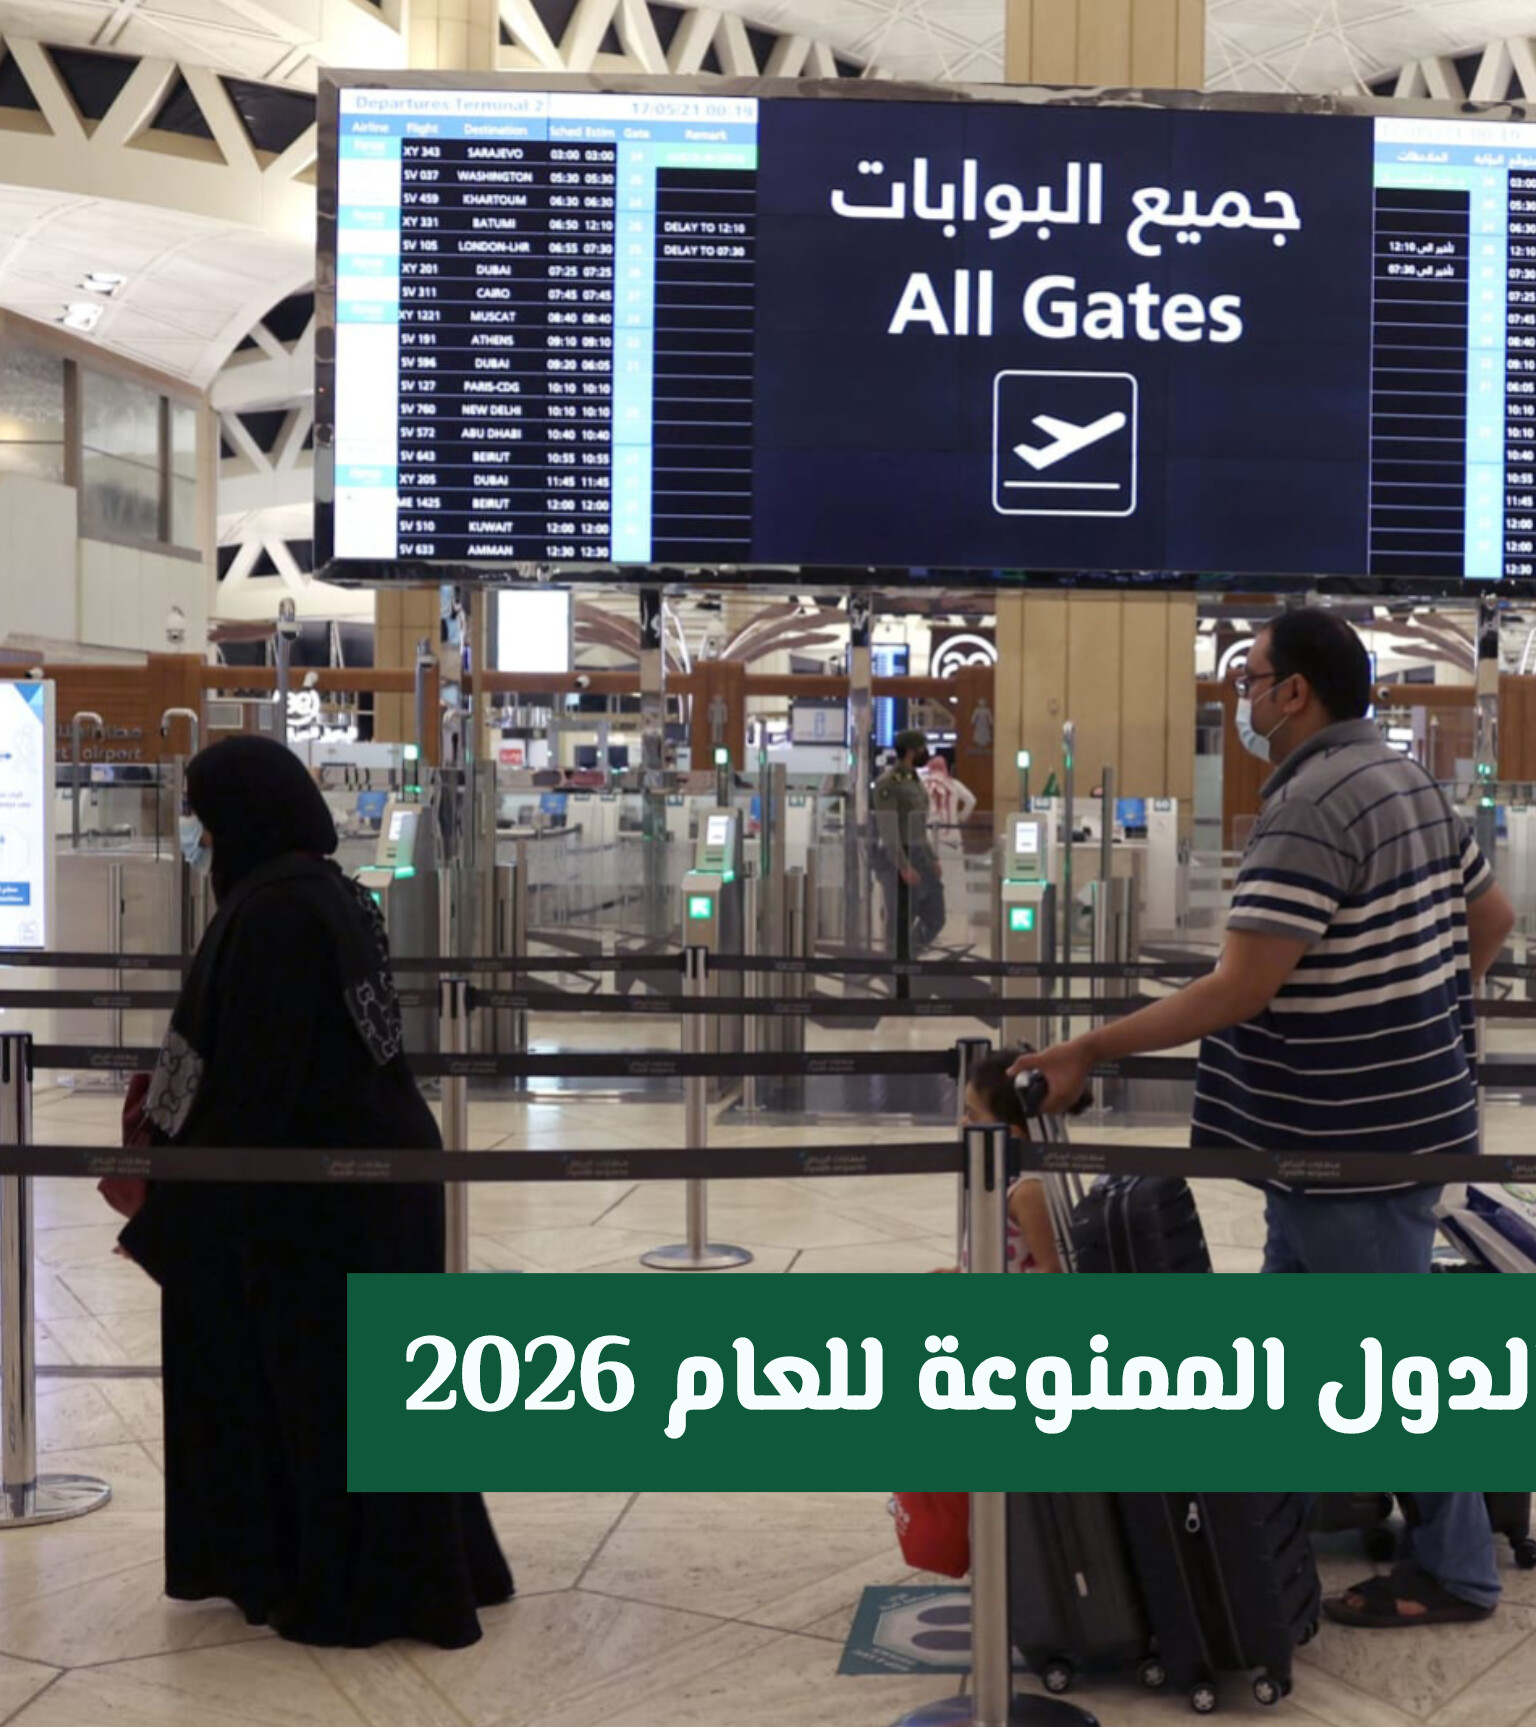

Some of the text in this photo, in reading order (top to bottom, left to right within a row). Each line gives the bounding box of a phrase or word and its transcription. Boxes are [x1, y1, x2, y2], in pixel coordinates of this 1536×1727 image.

[356, 96, 545, 113] Departures Terminal 2
[351, 121, 390, 134] Airline
[406, 122, 439, 137] Flight
[463, 123, 529, 137] Destination
[549, 126, 583, 139] Sched
[623, 128, 651, 140] Gate
[684, 128, 728, 141] Remark
[403, 146, 419, 159] XY
[466, 147, 524, 160] SARAJEVO
[403, 170, 419, 182] SV
[456, 171, 534, 183] WASHINGTON
[403, 193, 418, 205] SV
[462, 194, 528, 206] KHARTOUM
[831, 157, 1301, 257] جميع البوابات
[402, 216, 418, 229] XY
[472, 217, 518, 230] BATUMI
[664, 221, 698, 234] DELAY
[699, 221, 716, 234] TO
[718, 222, 746, 235] 12:10
[403, 240, 418, 252] SV
[458, 241, 530, 253] LONDON-LHR
[663, 244, 697, 257] DELAY
[698, 244, 715, 257] TO
[717, 245, 746, 258] 07:30
[402, 263, 418, 276] XY
[476, 264, 512, 276] DUBAI
[402, 286, 417, 299] SV
[476, 287, 510, 300] CAIRO
[888, 268, 1243, 343] All Gates
[398, 310, 417, 322] XY
[470, 311, 516, 323] MUSCAT
[402, 333, 417, 346] SV
[470, 334, 514, 346] ATHENS
[402, 356, 416, 369] SV
[474, 357, 510, 370] DUBAI
[401, 380, 416, 392] SV
[462, 381, 520, 393] PARIS-CDG
[401, 403, 416, 416] SV
[462, 404, 486, 416] NEW
[489, 404, 522, 416] DELHI
[401, 426, 415, 439] SV
[461, 427, 486, 440] ABU
[489, 427, 522, 440] DHABI
[401, 450, 415, 462] SV
[472, 451, 510, 463] BEIRUT
[400, 473, 415, 486] XY
[472, 474, 508, 486] DUBAI
[472, 497, 510, 510] BEIRUT
[400, 520, 414, 532] SV
[468, 521, 514, 533] KUWAIT
[400, 543, 414, 556] SV
[468, 544, 514, 556] AMMAN
[82, 745, 142, 762] airport
